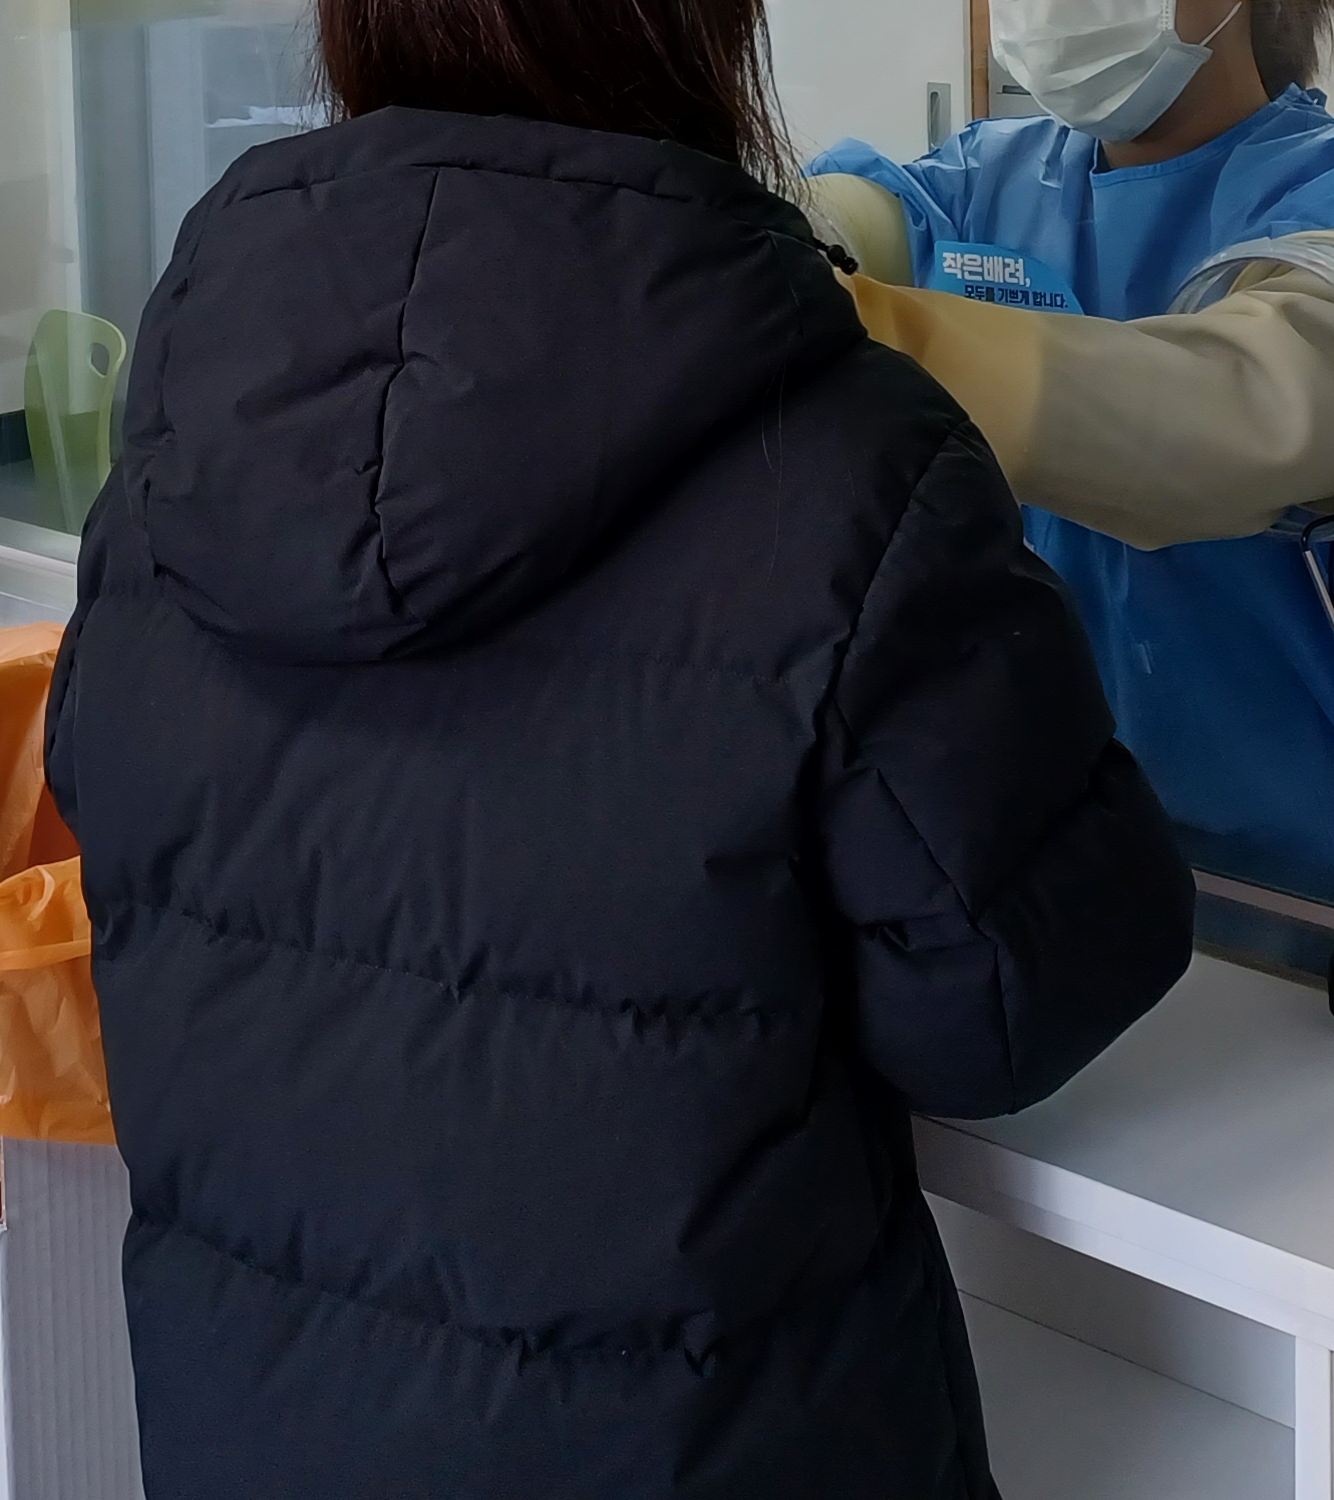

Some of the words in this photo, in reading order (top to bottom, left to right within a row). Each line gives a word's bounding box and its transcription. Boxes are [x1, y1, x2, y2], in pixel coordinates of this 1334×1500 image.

[942, 252, 1031, 287] 작은배려,
[964, 284, 995, 302] 모두를
[997, 288, 1030, 305] 기쁘게
[1032, 290, 1069, 310] 합니다.
